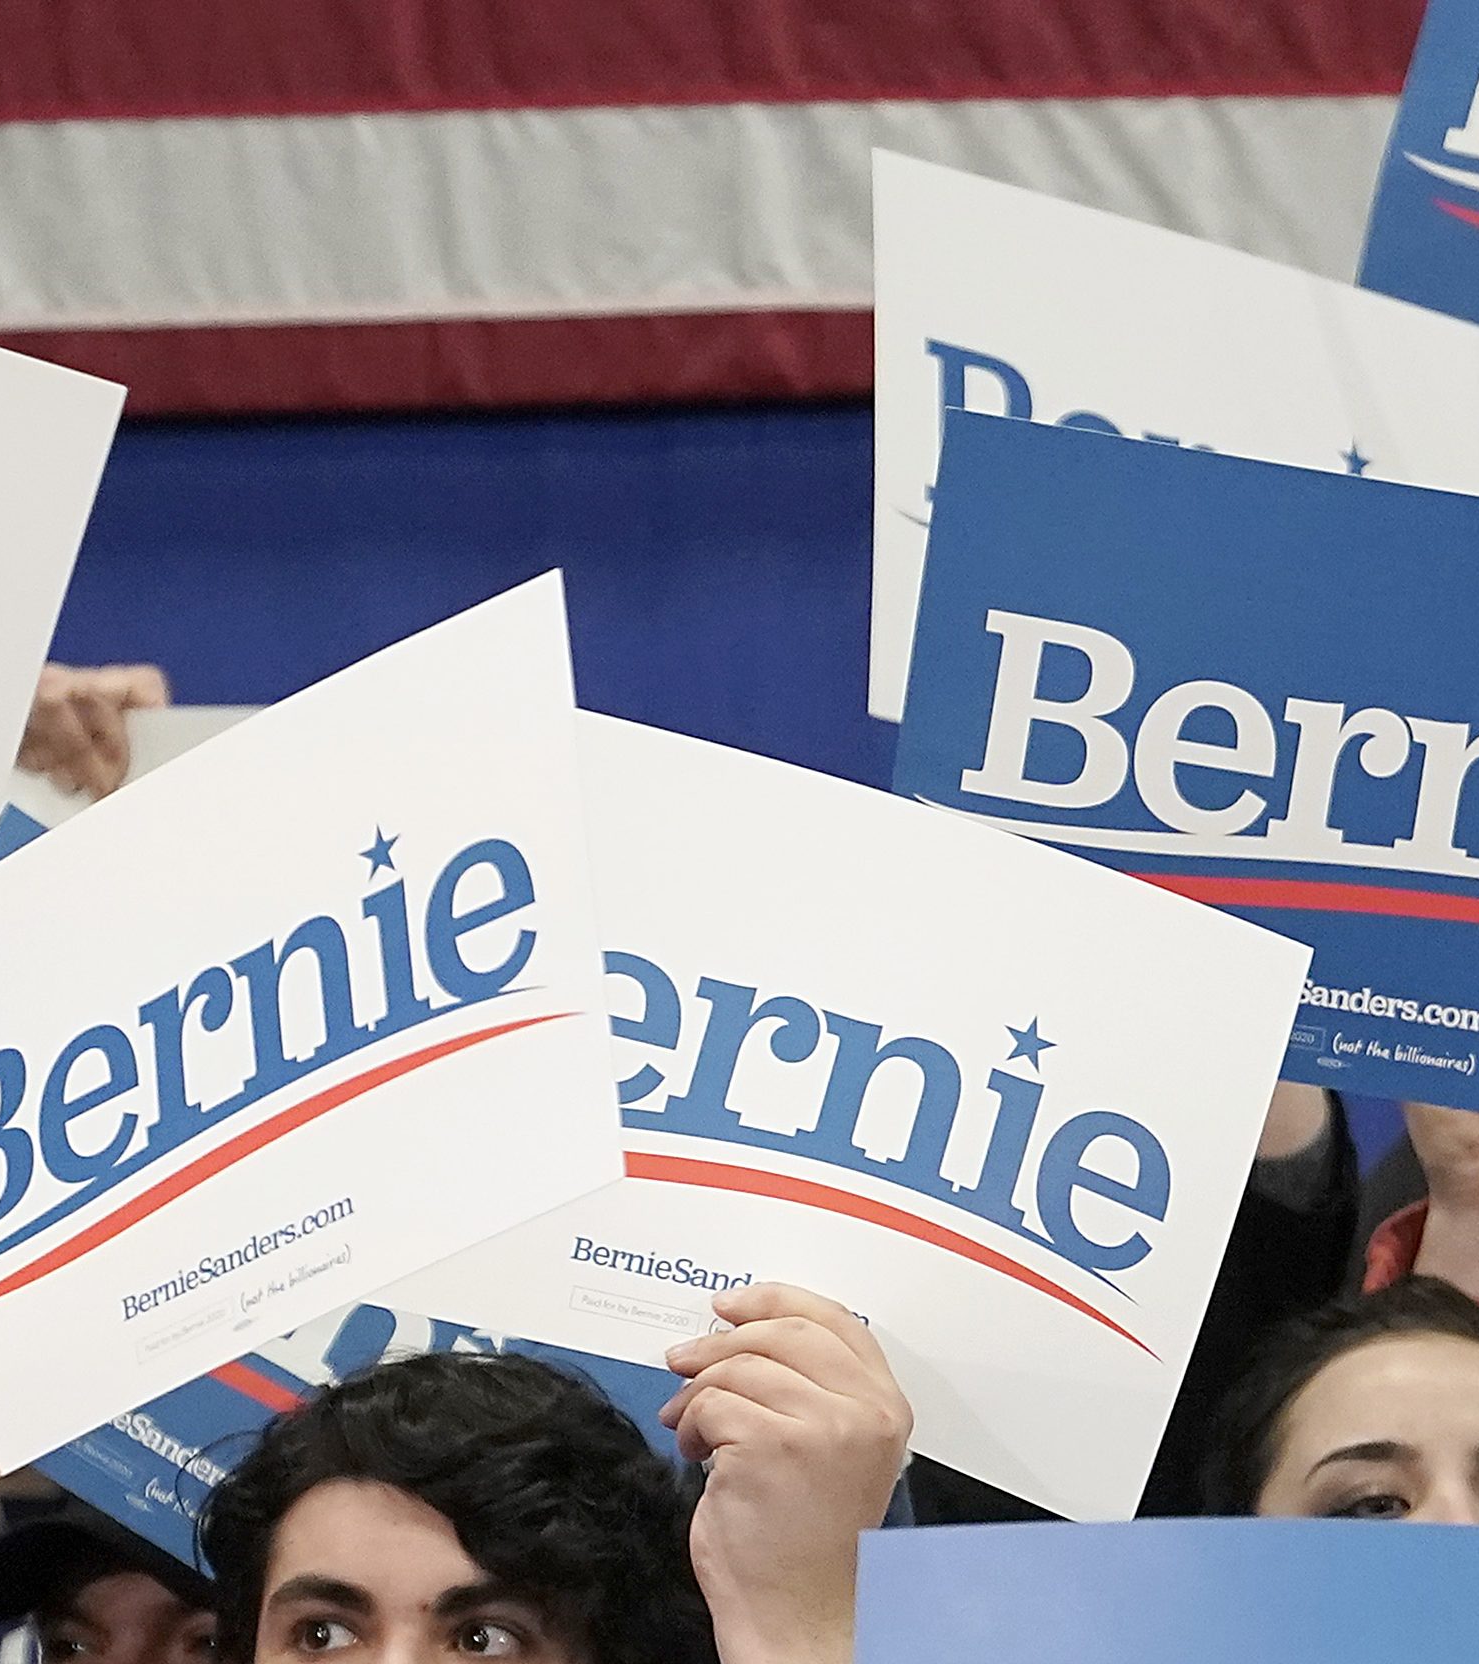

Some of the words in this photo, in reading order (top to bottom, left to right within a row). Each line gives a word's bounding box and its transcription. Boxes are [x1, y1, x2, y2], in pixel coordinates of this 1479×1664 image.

[602, 950, 1173, 1274] ernie
[1332, 1031, 1363, 1055] (not
[1366, 1041, 1390, 1059] the
[1394, 1044, 1476, 1076] billionaires)
[121, 1196, 355, 1322] BernieSanders.com
